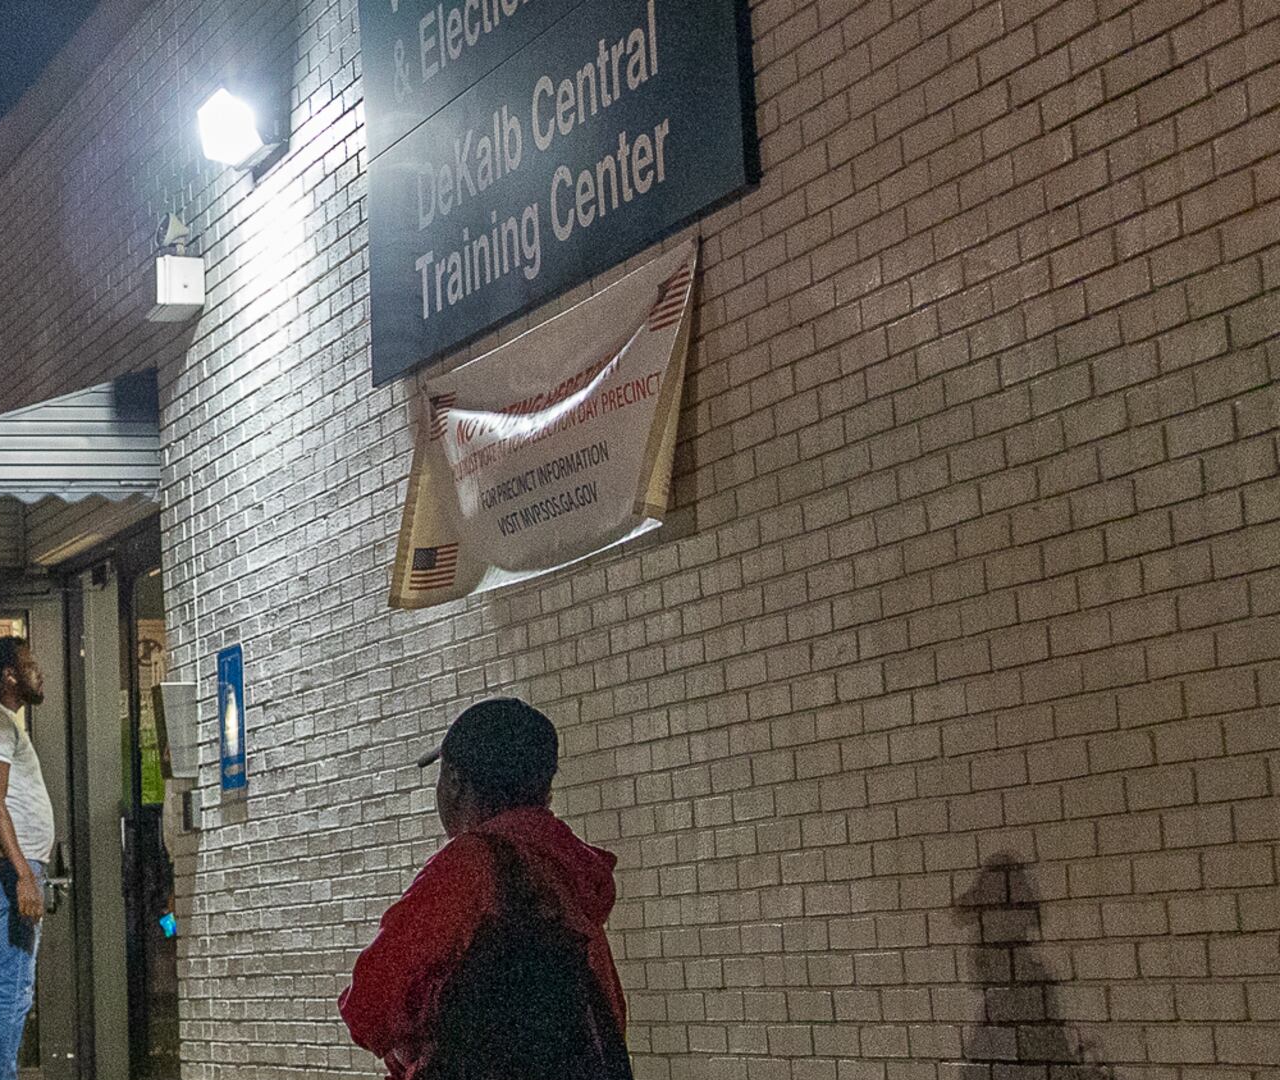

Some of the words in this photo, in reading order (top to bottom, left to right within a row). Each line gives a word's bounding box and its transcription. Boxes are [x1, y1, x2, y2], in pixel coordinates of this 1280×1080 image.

[393, 38, 413, 98] &
[417, 105, 523, 231] DeKalb
[532, 0, 659, 151] Central
[415, 203, 541, 320] Training
[551, 118, 669, 242] Center
[578, 397, 599, 424] DAY
[601, 371, 661, 414] PRECINCT
[497, 470, 537, 504] PRECINCT
[536, 440, 609, 487] INFORMATION
[497, 502, 522, 537] VISIT
